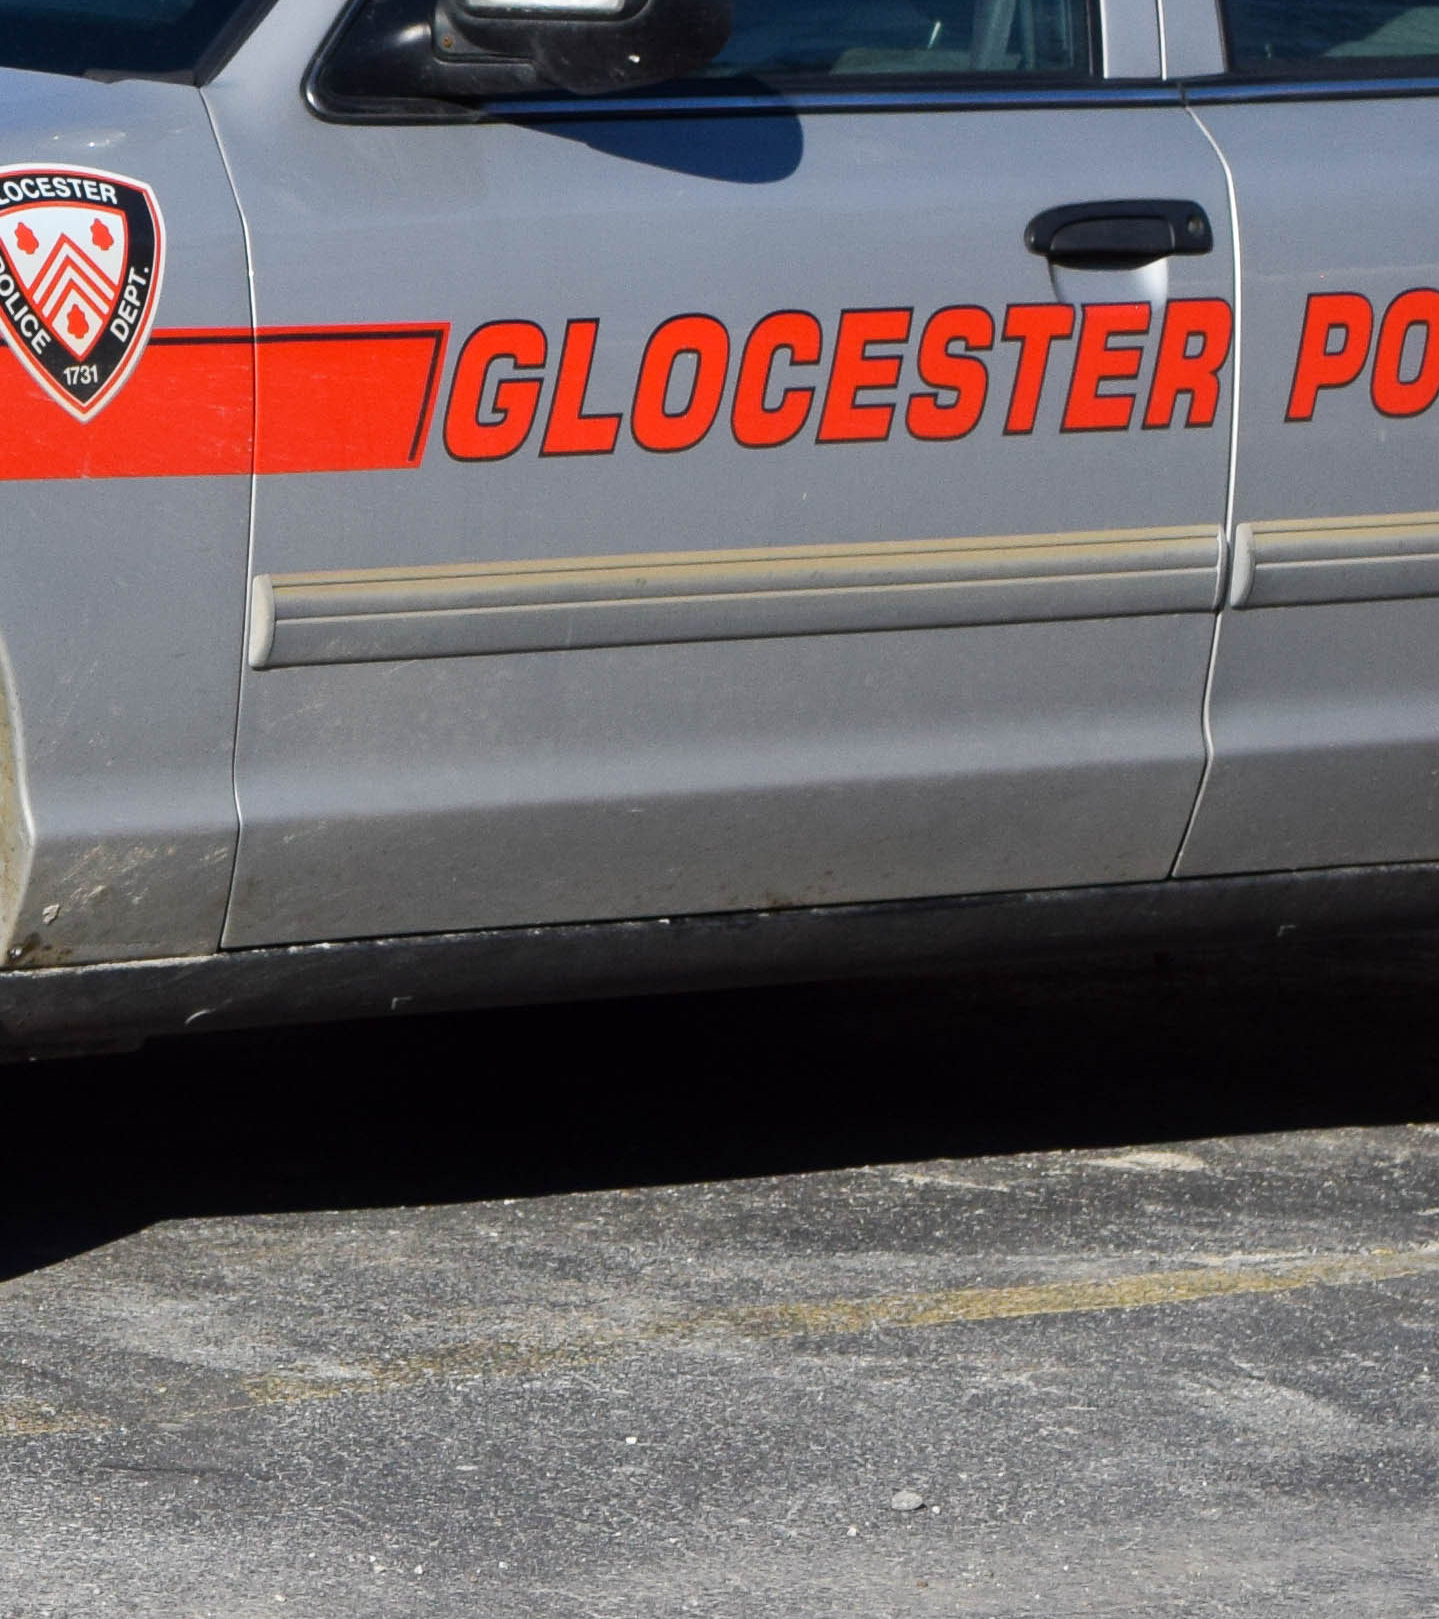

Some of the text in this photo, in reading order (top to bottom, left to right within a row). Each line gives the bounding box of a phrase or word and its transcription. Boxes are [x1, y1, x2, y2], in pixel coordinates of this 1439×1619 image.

[109, 266, 150, 343] DEPT.
[63, 365, 98, 385] 1731
[440, 297, 1237, 462] GLOCESTER
